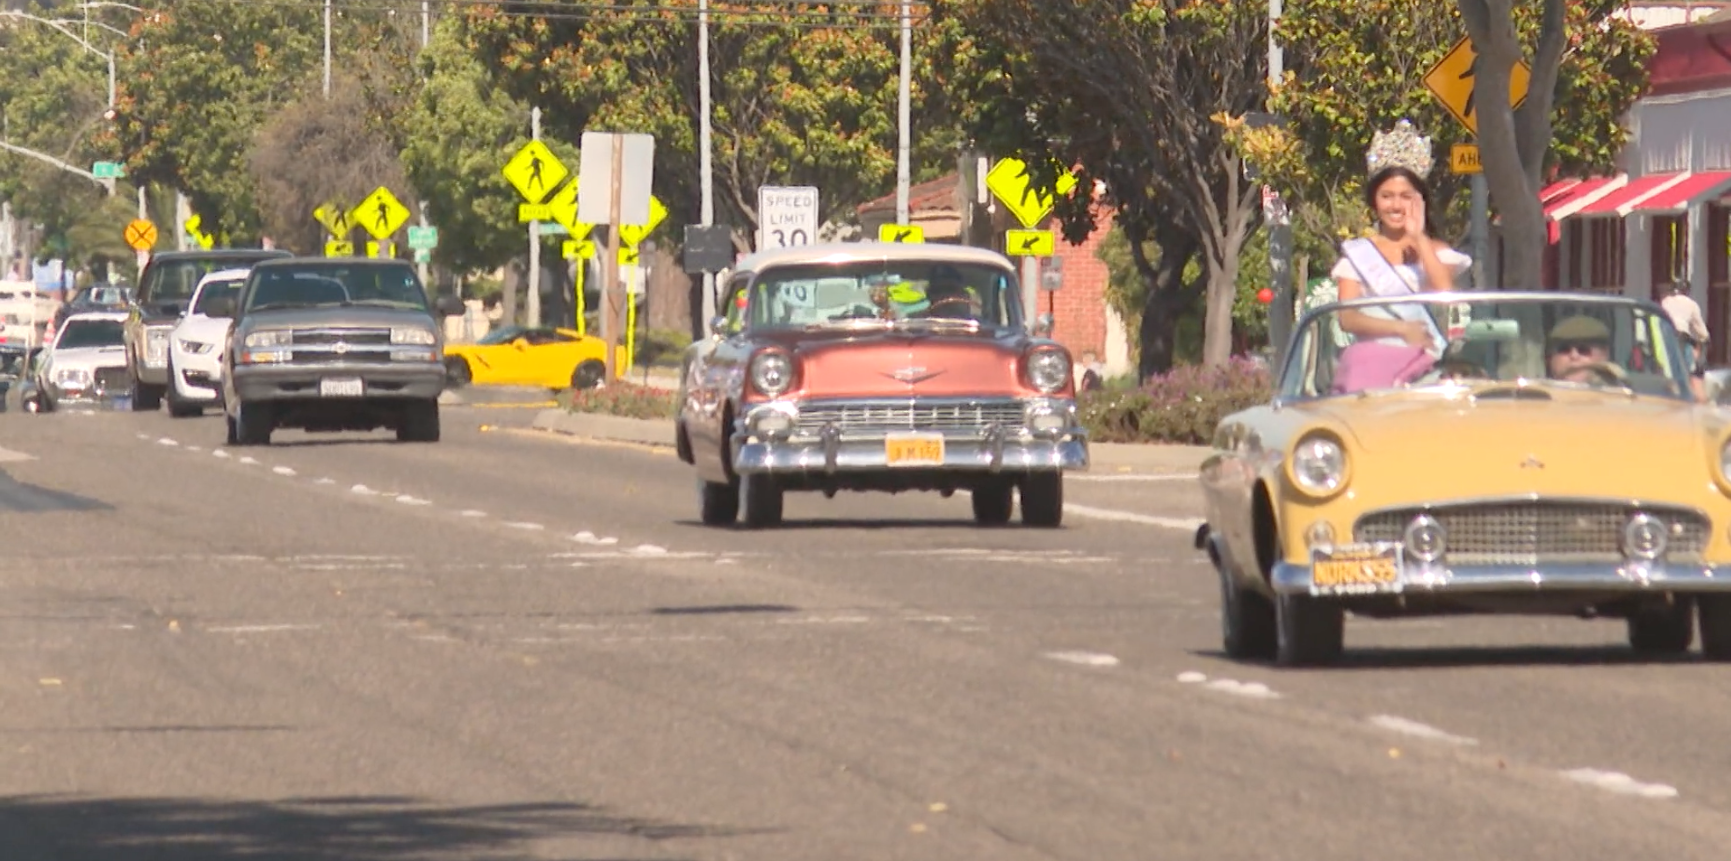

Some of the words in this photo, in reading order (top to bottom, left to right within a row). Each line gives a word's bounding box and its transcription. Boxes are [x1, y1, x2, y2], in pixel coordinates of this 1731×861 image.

[766, 195, 812, 207] SPEED
[770, 213, 806, 225] LIMIT
[771, 228, 808, 247] 30
